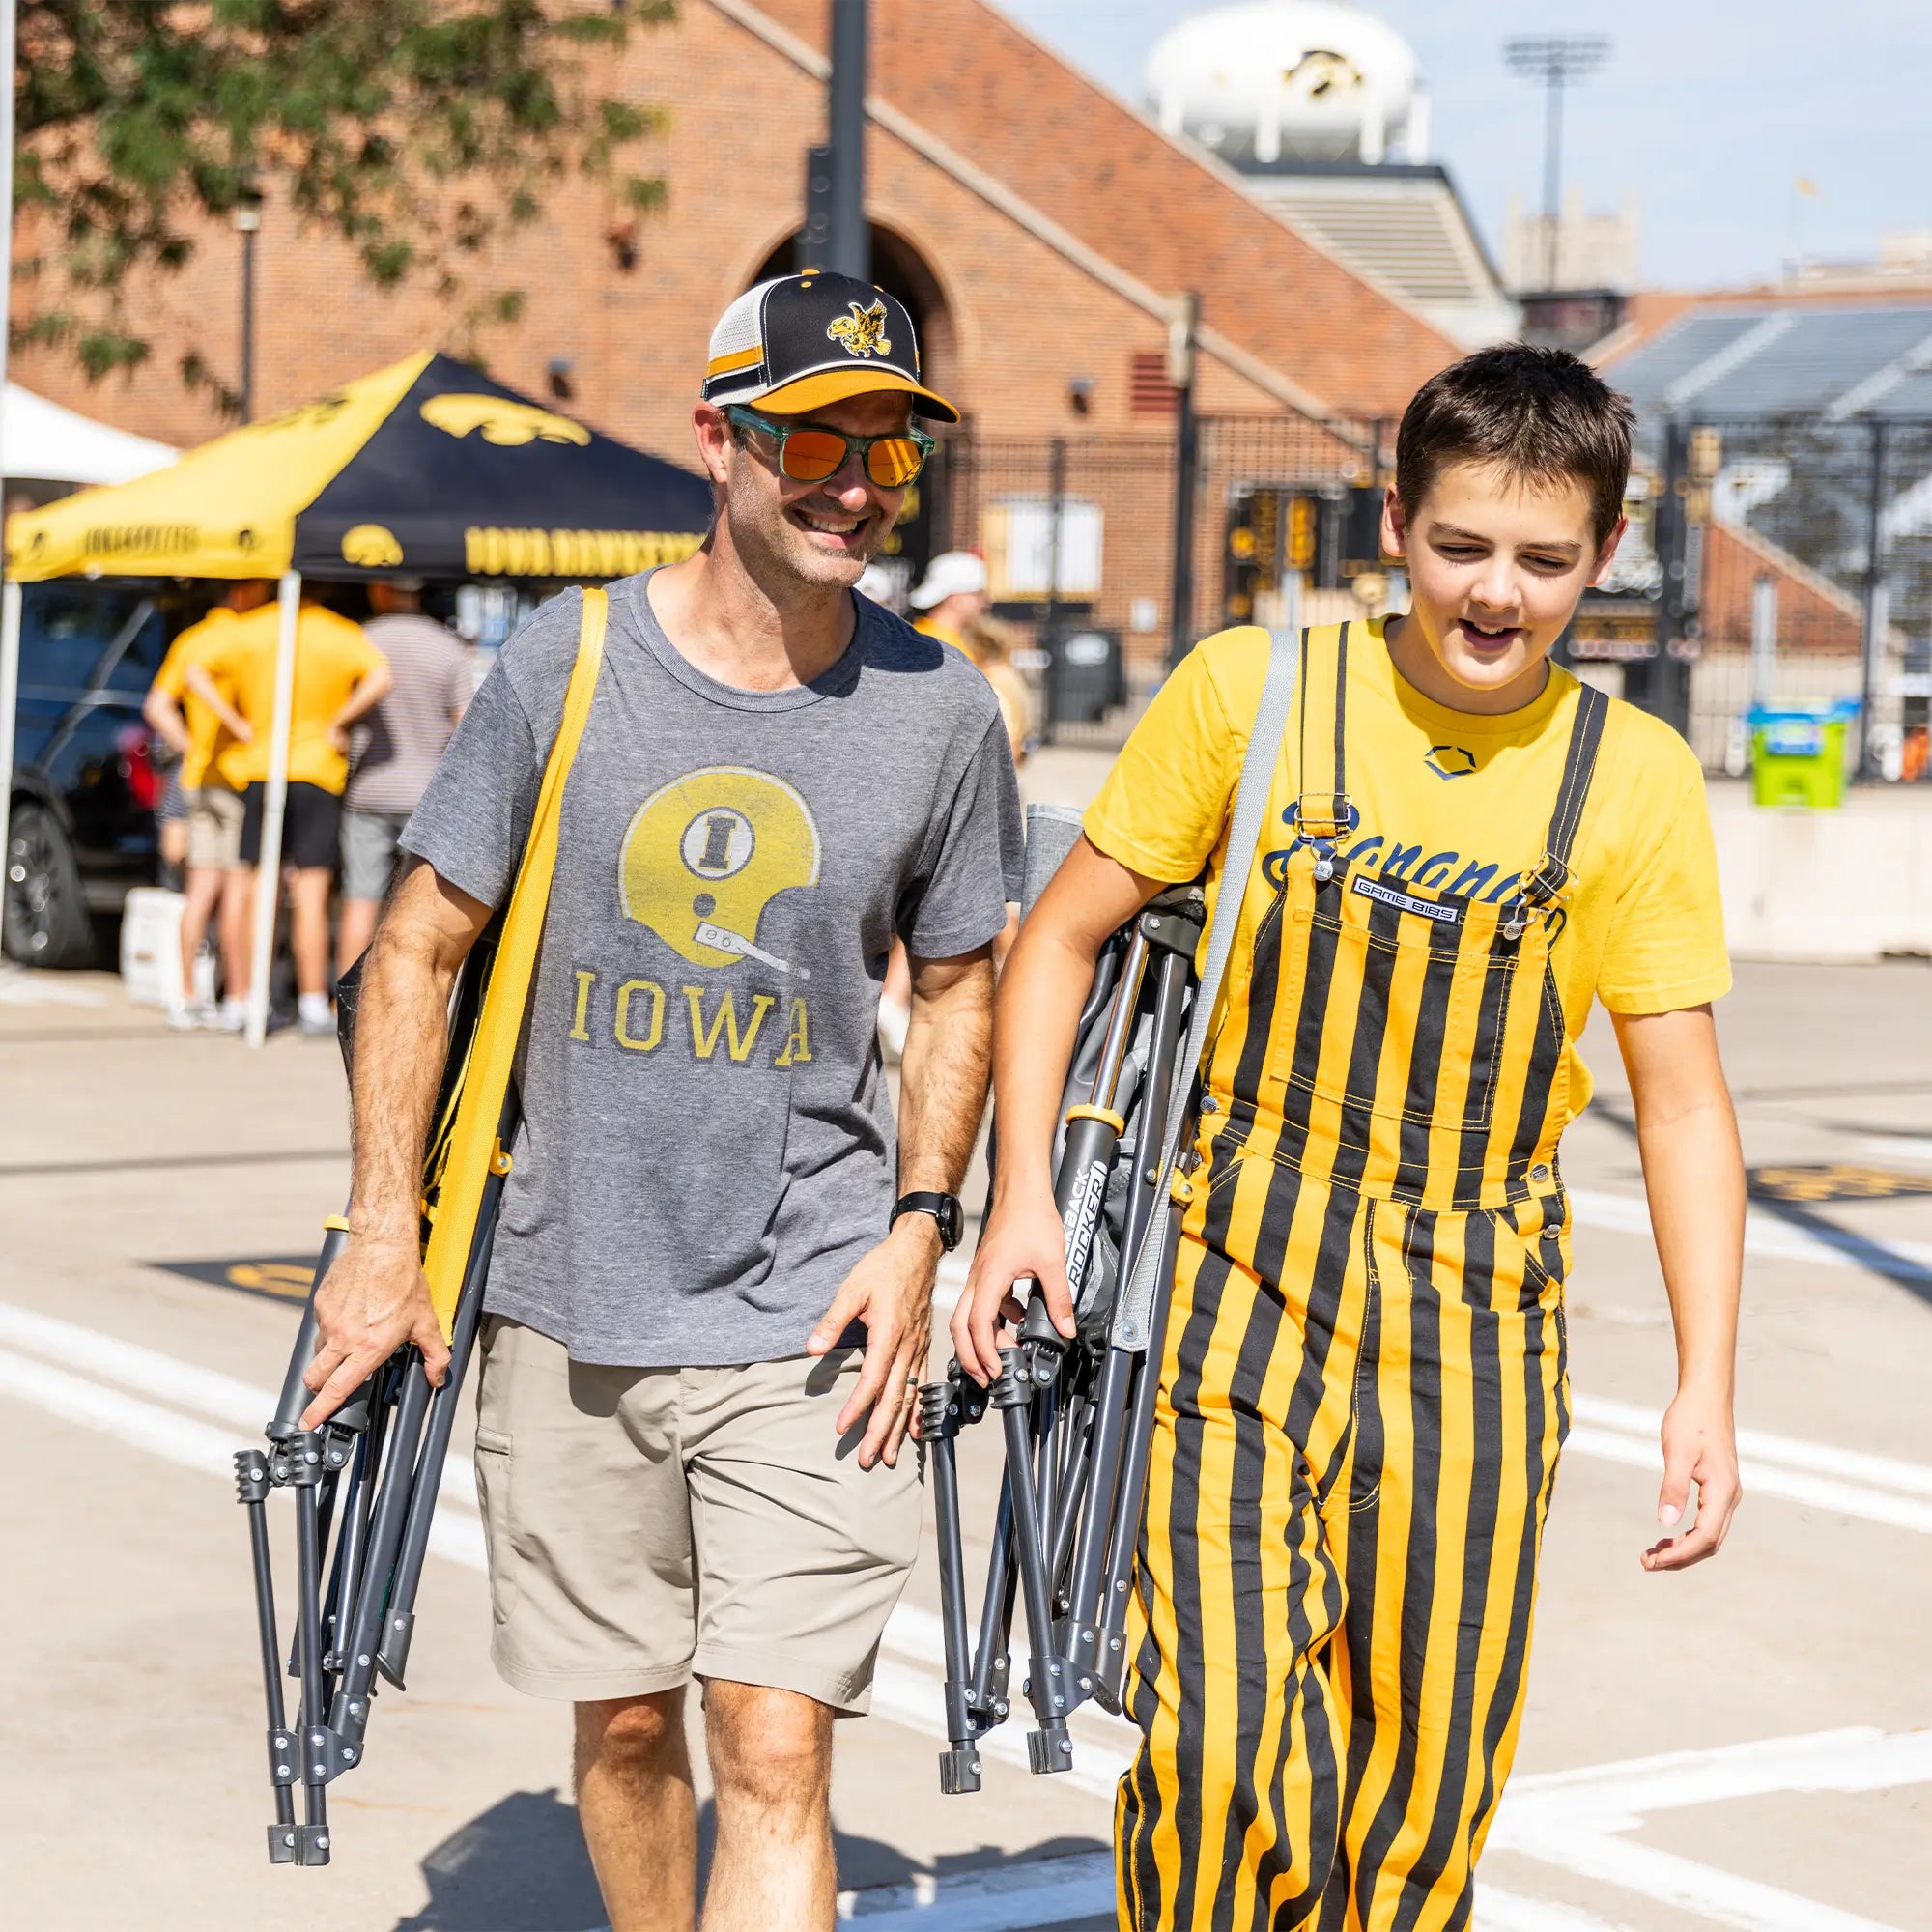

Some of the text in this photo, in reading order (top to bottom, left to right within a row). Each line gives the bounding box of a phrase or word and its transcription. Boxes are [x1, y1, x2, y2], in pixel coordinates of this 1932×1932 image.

[699, 816, 737, 869] I
[1358, 881, 1454, 919] GAME BIBS
[569, 969, 812, 1066] IOWA
[1068, 1178, 1103, 1288] ROCKER
